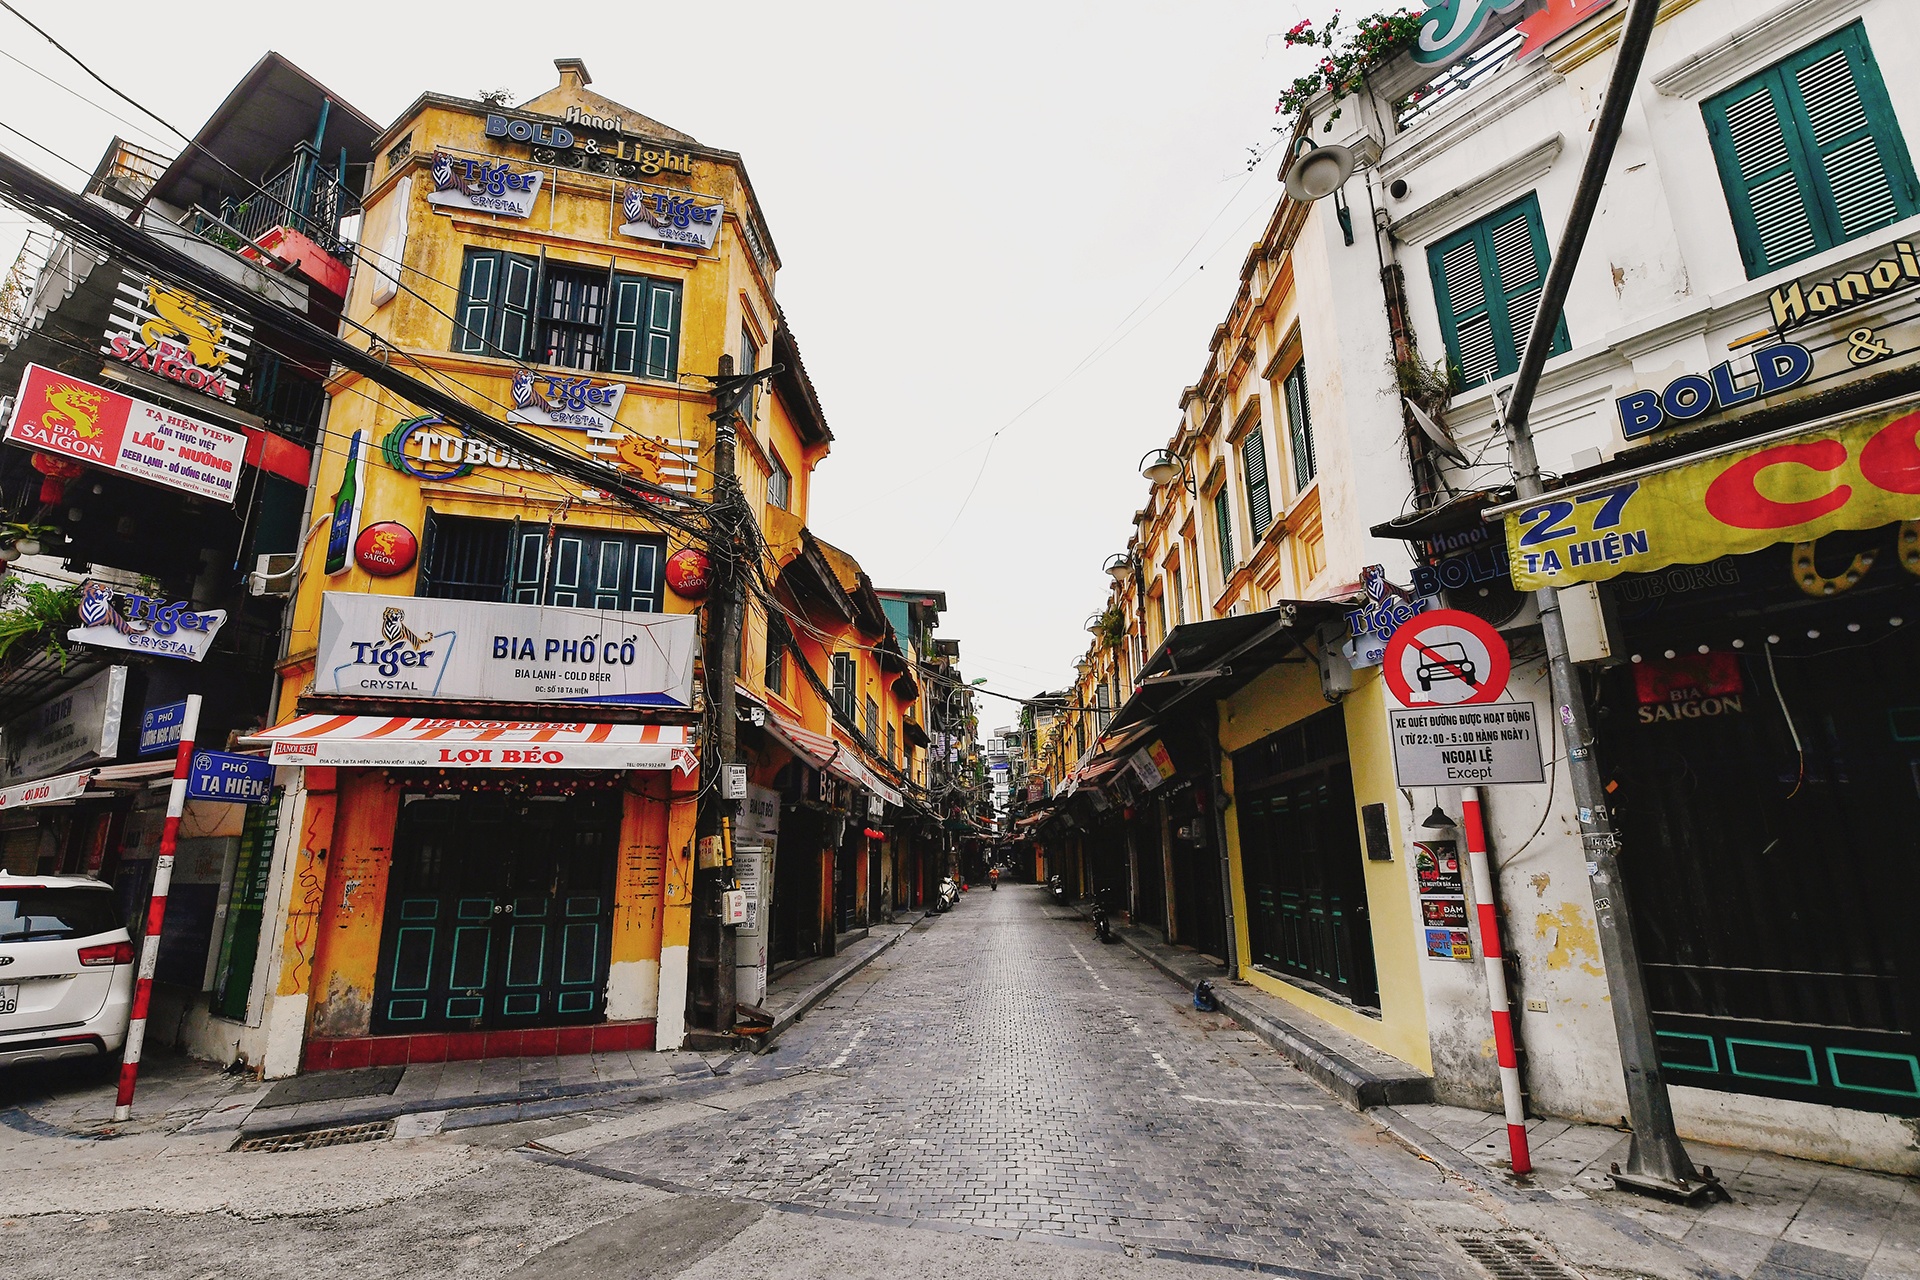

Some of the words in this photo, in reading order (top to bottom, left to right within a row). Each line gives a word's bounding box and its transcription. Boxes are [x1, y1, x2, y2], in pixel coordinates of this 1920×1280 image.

[565, 105, 622, 134] Hanoi
[485, 114, 573, 148] BOLD
[584, 138, 600, 154] &
[615, 140, 692, 175] Light
[459, 158, 537, 196] Tiger
[470, 194, 524, 213] CRYSTAL
[651, 192, 718, 228] Tiger
[658, 227, 706, 245] CRYSTAL
[1769, 241, 1920, 331] Hanoi
[160, 341, 196, 365] BIA
[110, 337, 228, 398] SAIGON
[545, 375, 617, 412] Tiger
[1616, 341, 1814, 441] BOLD
[1847, 327, 1893, 366] &
[53, 424, 78, 438] BIA
[145, 408, 164, 422] TẠ
[166, 416, 199, 432] HIỆN
[202, 427, 235, 444] VIEW
[550, 411, 604, 428] CRYSTAL
[20, 424, 104, 459] SAIGON
[175, 430, 197, 445] THỰC
[198, 438, 217, 451] VIỆT
[121, 448, 143, 464] BEER
[143, 454, 164, 468] LẠNH
[201, 472, 216, 484] CÁC
[178, 445, 232, 473] NƯỚNG
[1519, 481, 1640, 547] 27
[1431, 521, 1489, 553] Hanoi
[363, 551, 396, 566] SAIGON
[1523, 549, 1563, 576] TẠ
[1569, 530, 1650, 566] HIỆN
[124, 592, 219, 636] Tiger
[1343, 596, 1427, 643] Tiger
[128, 633, 197, 655] CRYSTAL
[493, 636, 536, 661] BIA
[544, 634, 599, 664] PHỐ
[603, 634, 637, 666] CỔ
[350, 640, 435, 678] Tiger
[360, 679, 419, 691] CRYSTAL
[515, 668, 530, 679] BIA
[533, 670, 556, 681] LẠNH
[564, 671, 587, 681] COLD
[589, 672, 611, 682] BEER
[557, 686, 565, 694] 18
[574, 686, 589, 695] HIỆN
[1669, 687, 1701, 701] BIA
[157, 708, 175, 724] PHỐ
[1396, 718, 1406, 728] XE
[1408, 712, 1428, 728] QUÉT
[1430, 712, 1457, 727] ĐƯỜNG
[1460, 713, 1482, 726] ĐƯỢC
[1484, 712, 1505, 725] HOẠT
[1507, 709, 1530, 723] ĐỘNG
[1637, 694, 1743, 724] SAIGON
[517, 721, 578, 732] BEER
[1476, 730, 1498, 742] HÀNG
[275, 742, 299, 755] HANOI
[300, 743, 317, 755] BEER
[438, 748, 493, 766] LỢI
[501, 745, 564, 764] BÉO
[1442, 750, 1477, 765] NGOẠI
[1480, 747, 1493, 764] LỆ
[221, 761, 250, 774] PHỐ
[1447, 766, 1493, 780] Except
[201, 775, 220, 795] TẠ
[224, 775, 263, 797] HIỆN
